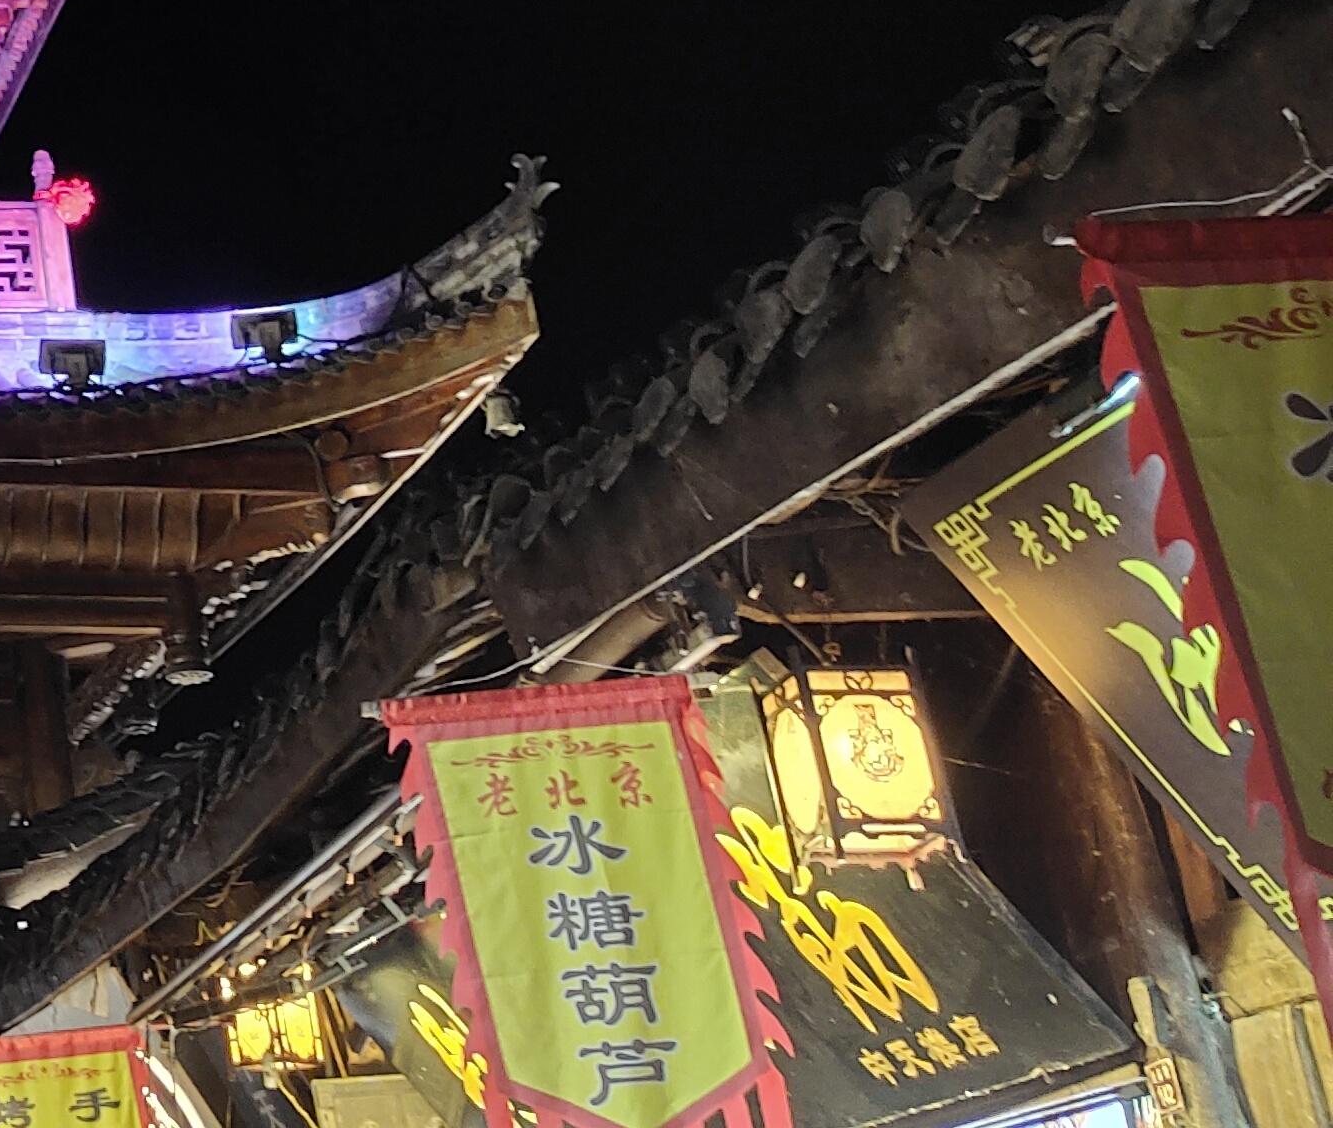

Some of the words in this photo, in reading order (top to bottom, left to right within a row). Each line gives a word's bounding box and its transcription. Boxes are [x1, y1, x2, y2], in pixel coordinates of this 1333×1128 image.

[1009, 482, 1121, 572] 老北京
[478, 761, 654, 818] 老北京
[528, 814, 677, 1108] 冰糖葫芦
